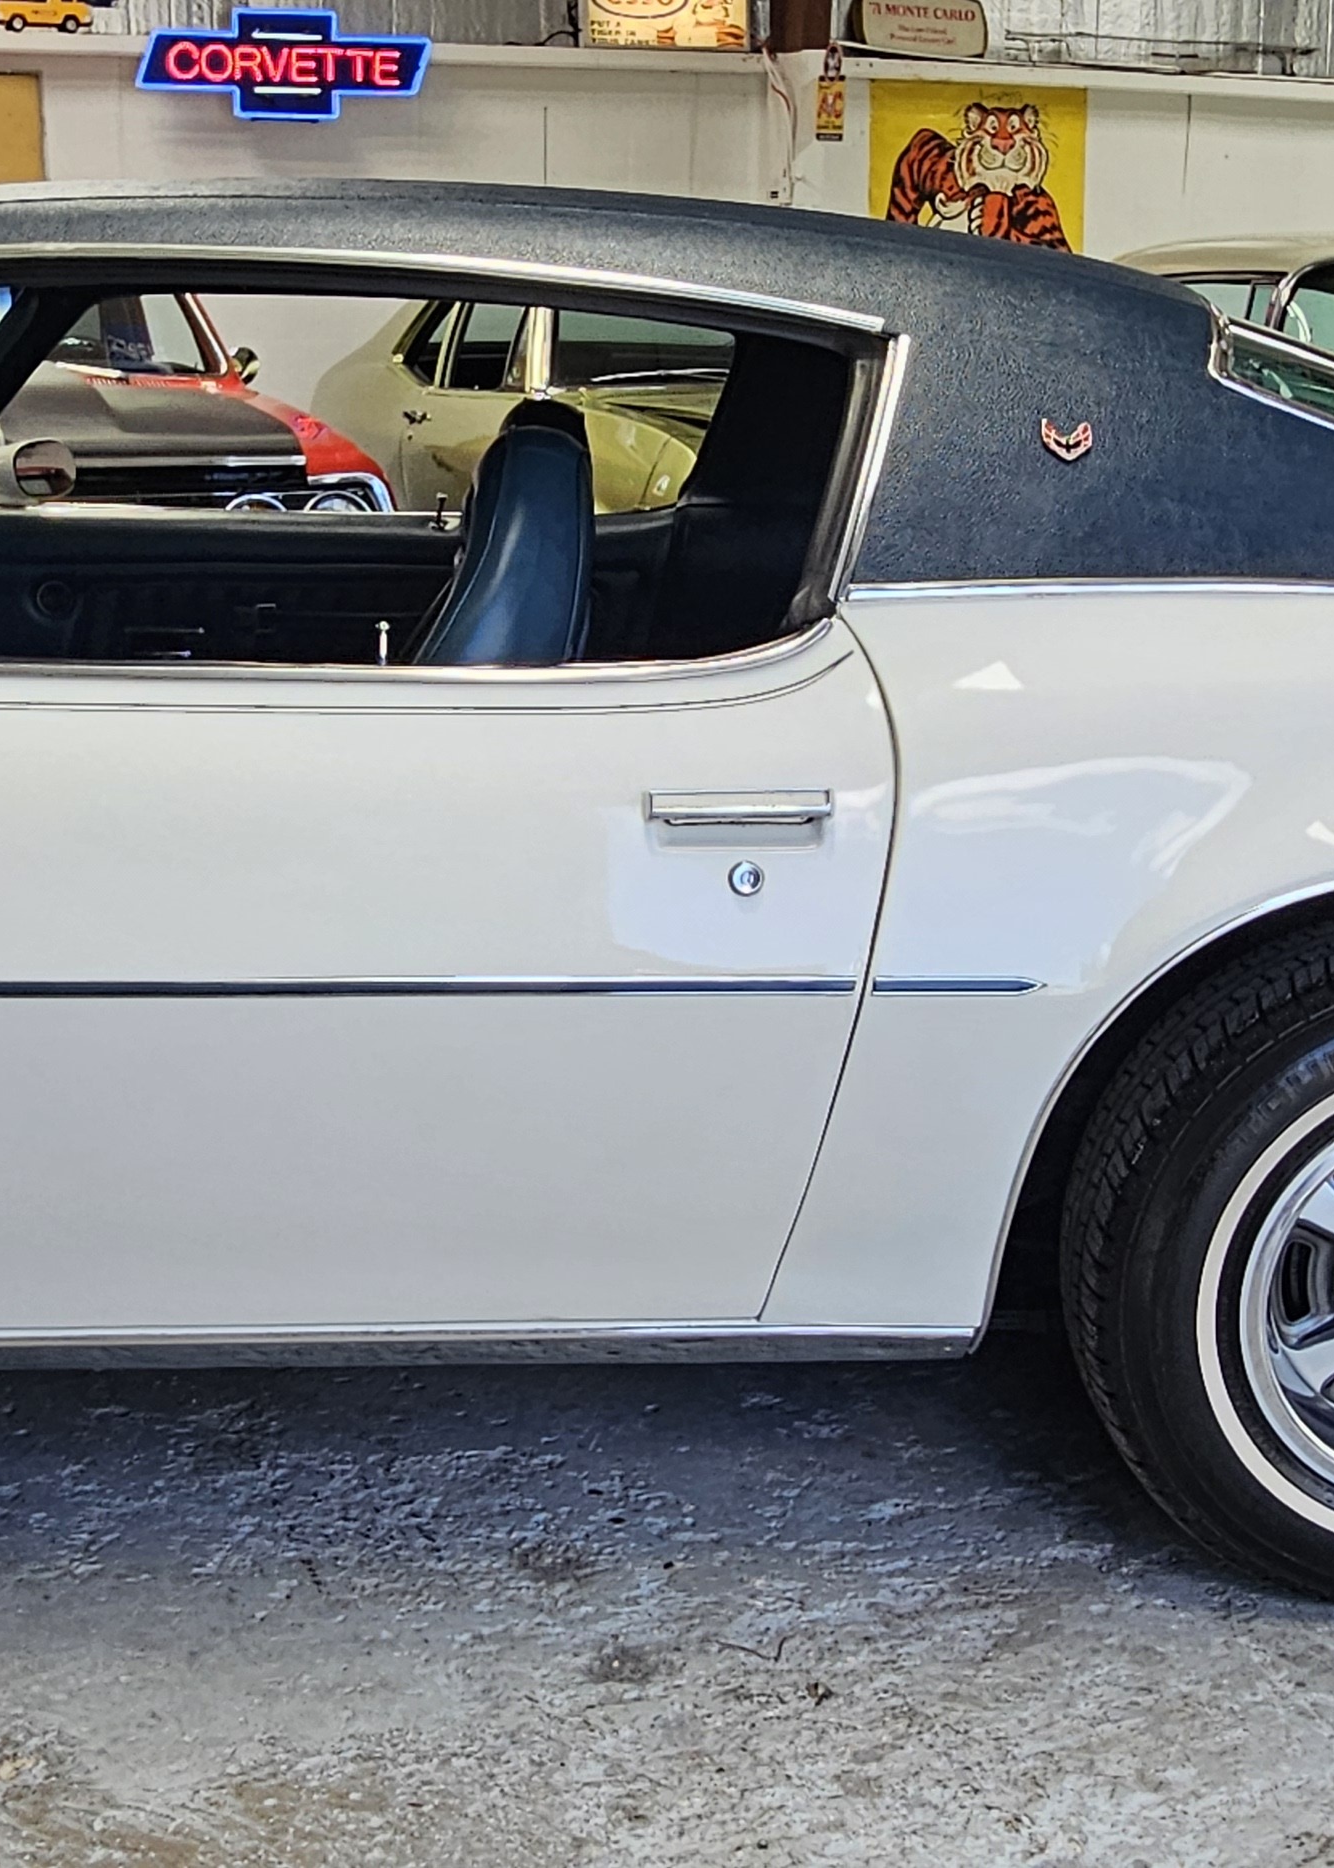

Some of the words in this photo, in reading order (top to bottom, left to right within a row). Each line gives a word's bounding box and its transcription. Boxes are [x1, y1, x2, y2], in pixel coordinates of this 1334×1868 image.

[885, 3, 929, 19] MONTE
[933, 7, 976, 23] CARLO
[166, 40, 402, 86] CORVETTE
